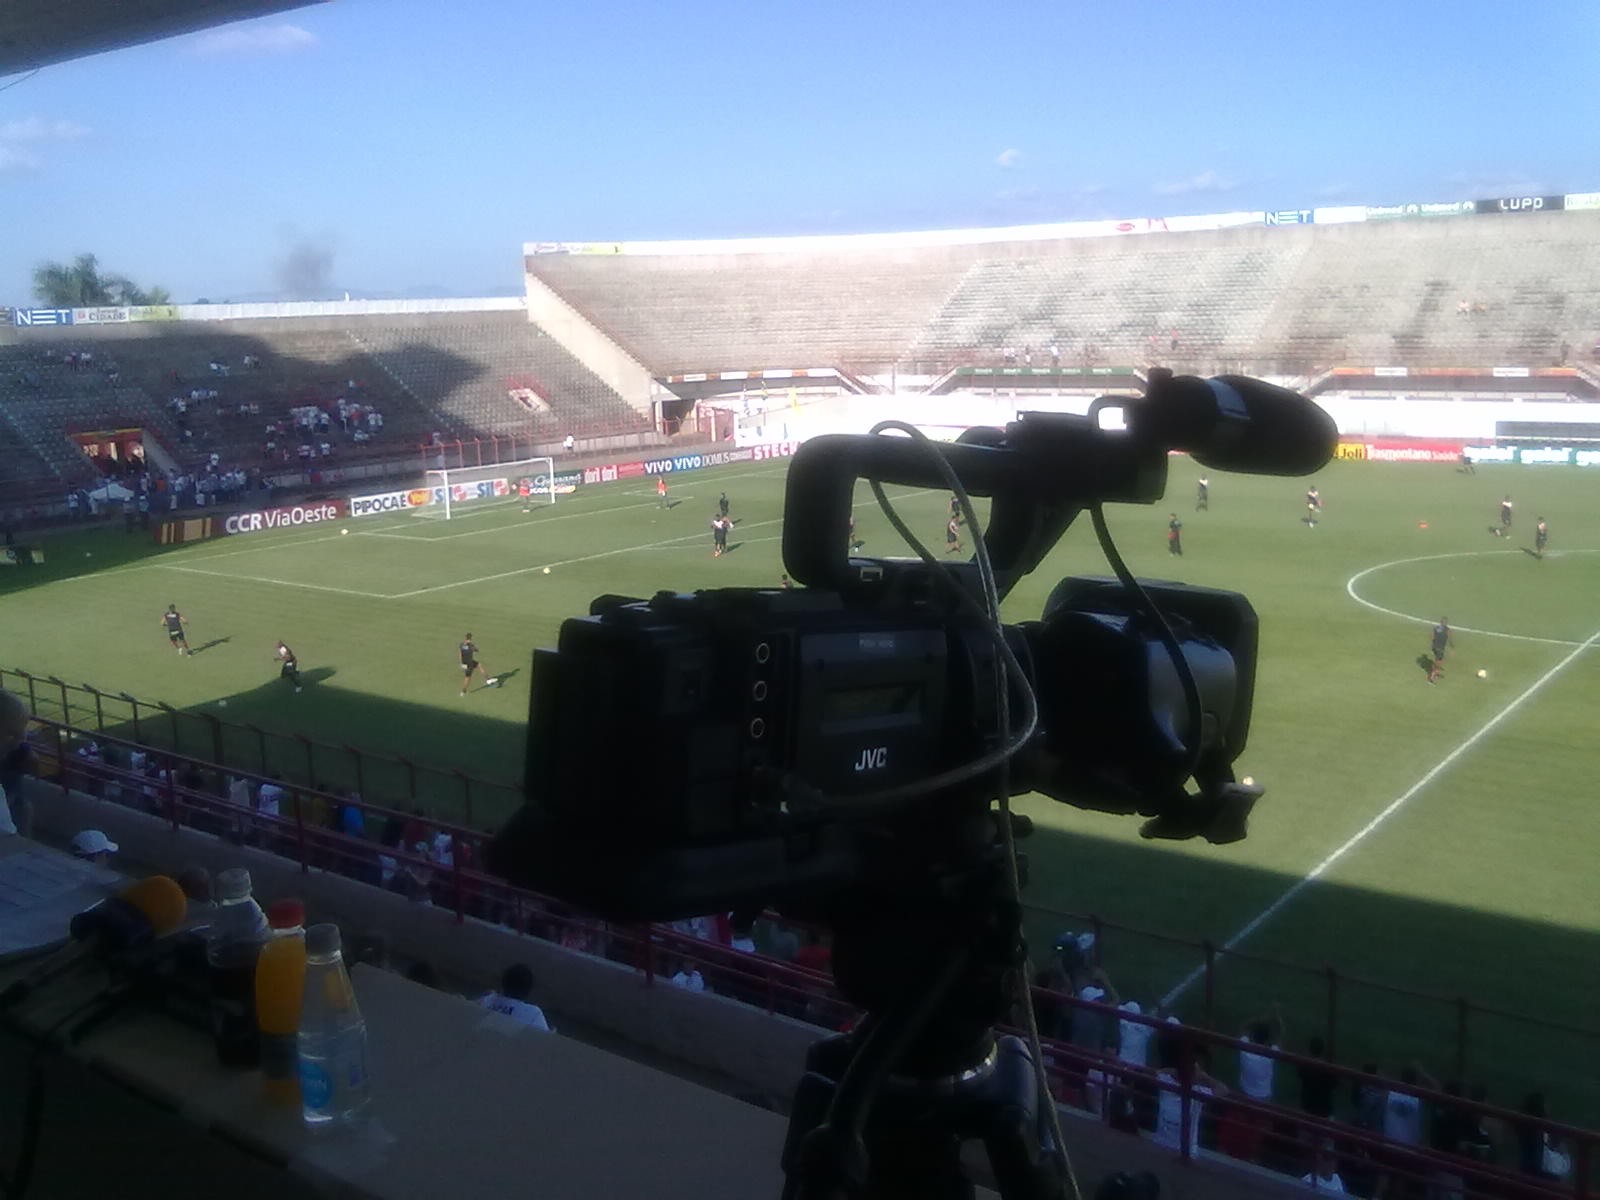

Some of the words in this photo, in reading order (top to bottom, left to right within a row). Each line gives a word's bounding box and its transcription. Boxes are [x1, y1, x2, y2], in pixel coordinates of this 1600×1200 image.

[1500, 197, 1543, 210] LUPO
[1266, 210, 1311, 225] NET
[16, 308, 70, 326] NET
[645, 460, 673, 475] VIVO
[674, 456, 701, 470] VIVO
[353, 495, 400, 515] PIPOCA
[226, 513, 262, 534] CCR
[264, 504, 337, 528] ViaOeste
[855, 747, 888, 771] JVC
